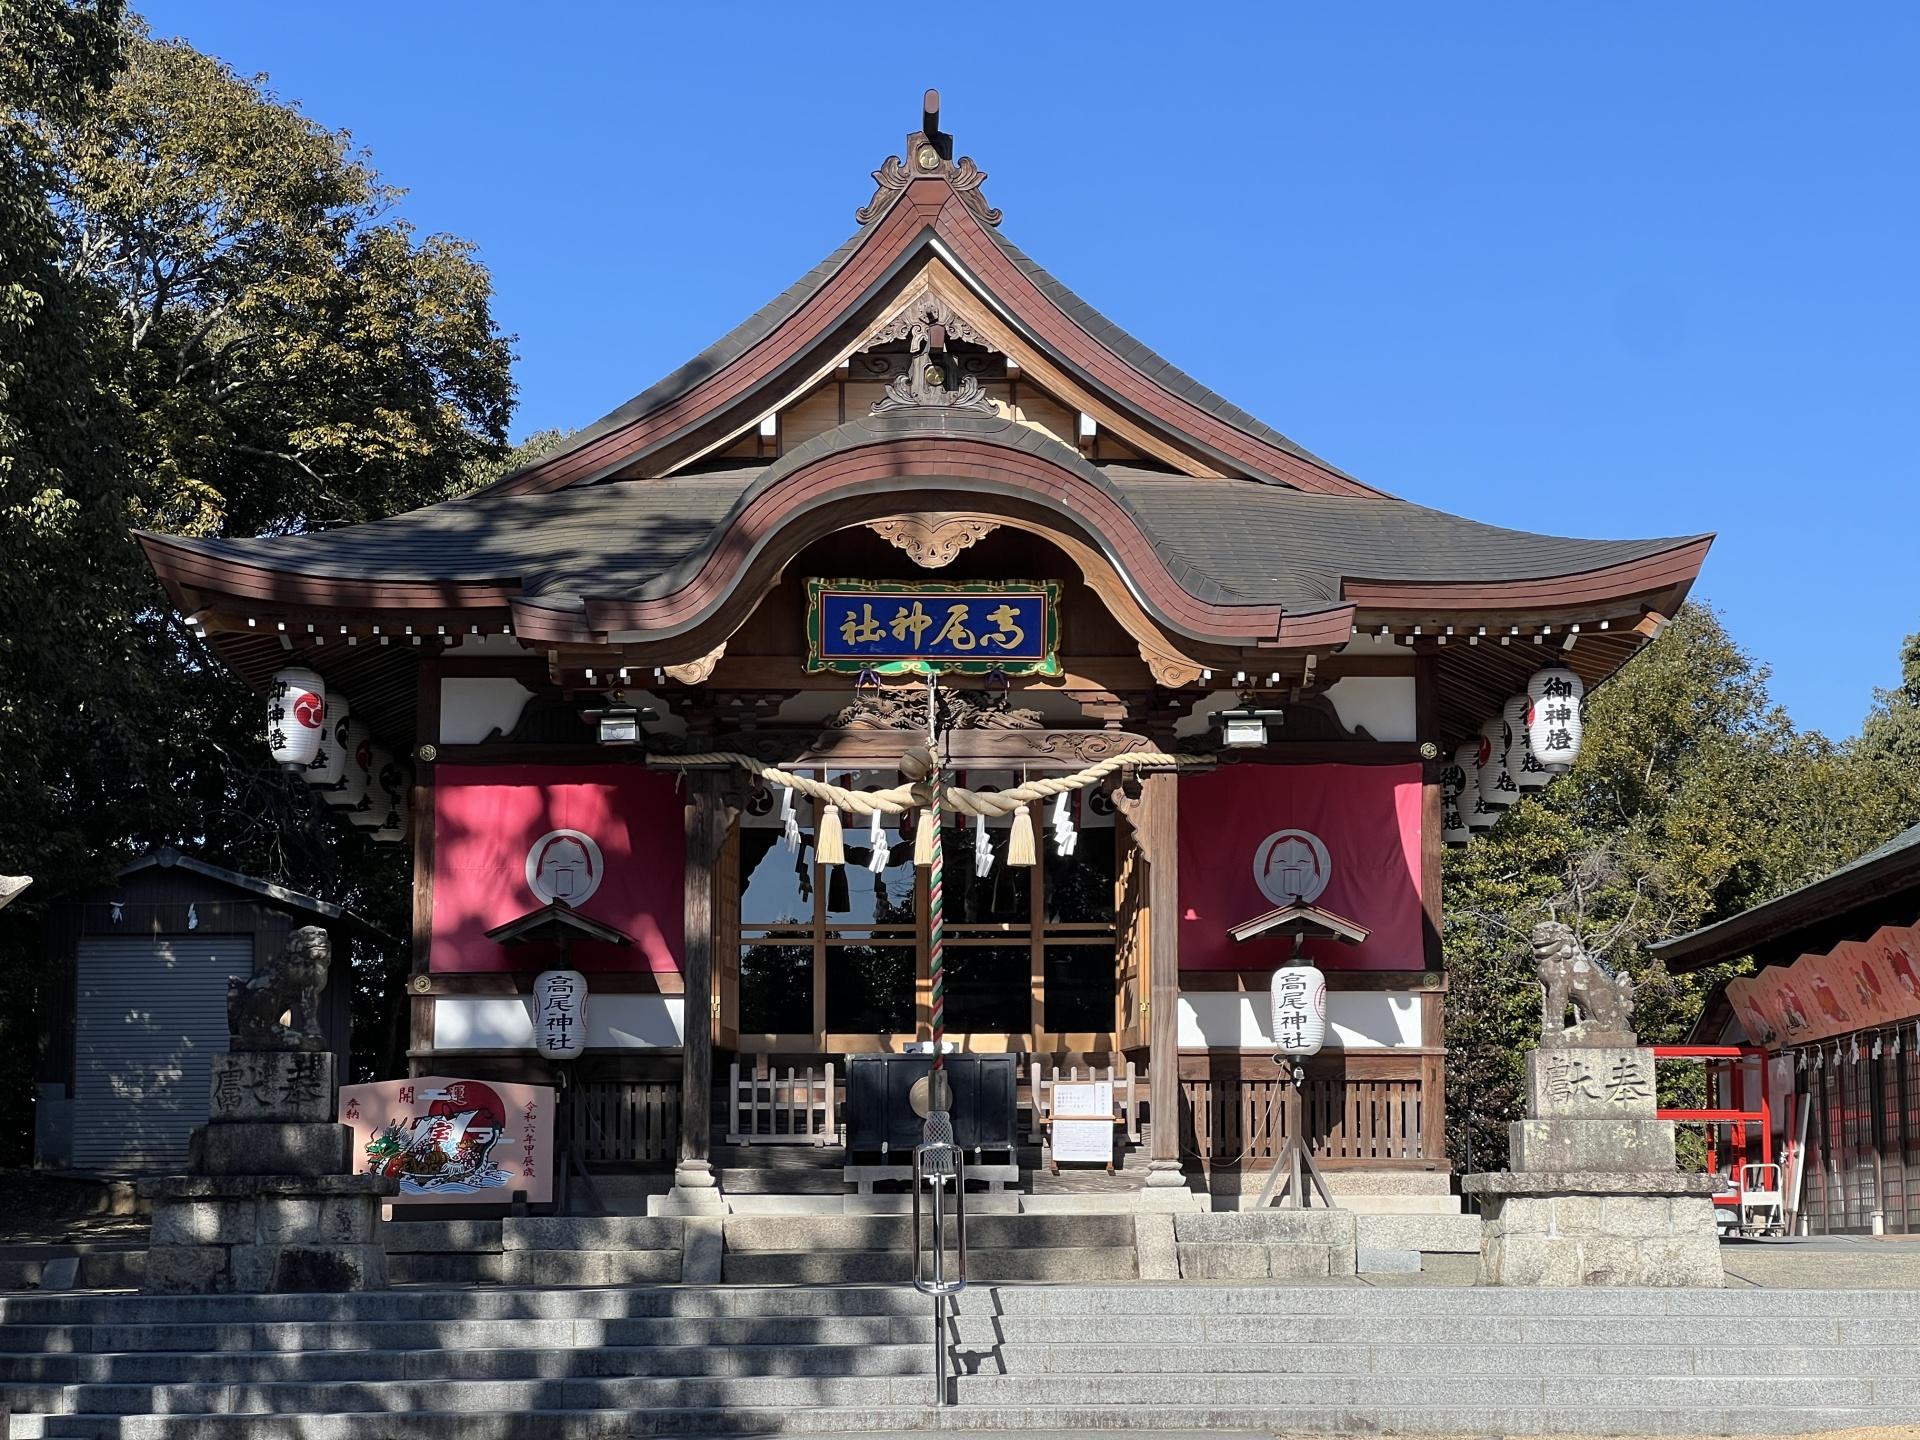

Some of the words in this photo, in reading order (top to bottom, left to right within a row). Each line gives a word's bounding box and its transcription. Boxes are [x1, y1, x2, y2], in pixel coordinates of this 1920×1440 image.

[1543, 676, 1573, 750] 御神燈
[544, 975, 575, 1051] 高尾神社
[1278, 972, 1312, 1049] 高尾神社
[345, 1097, 361, 1120] 奉納
